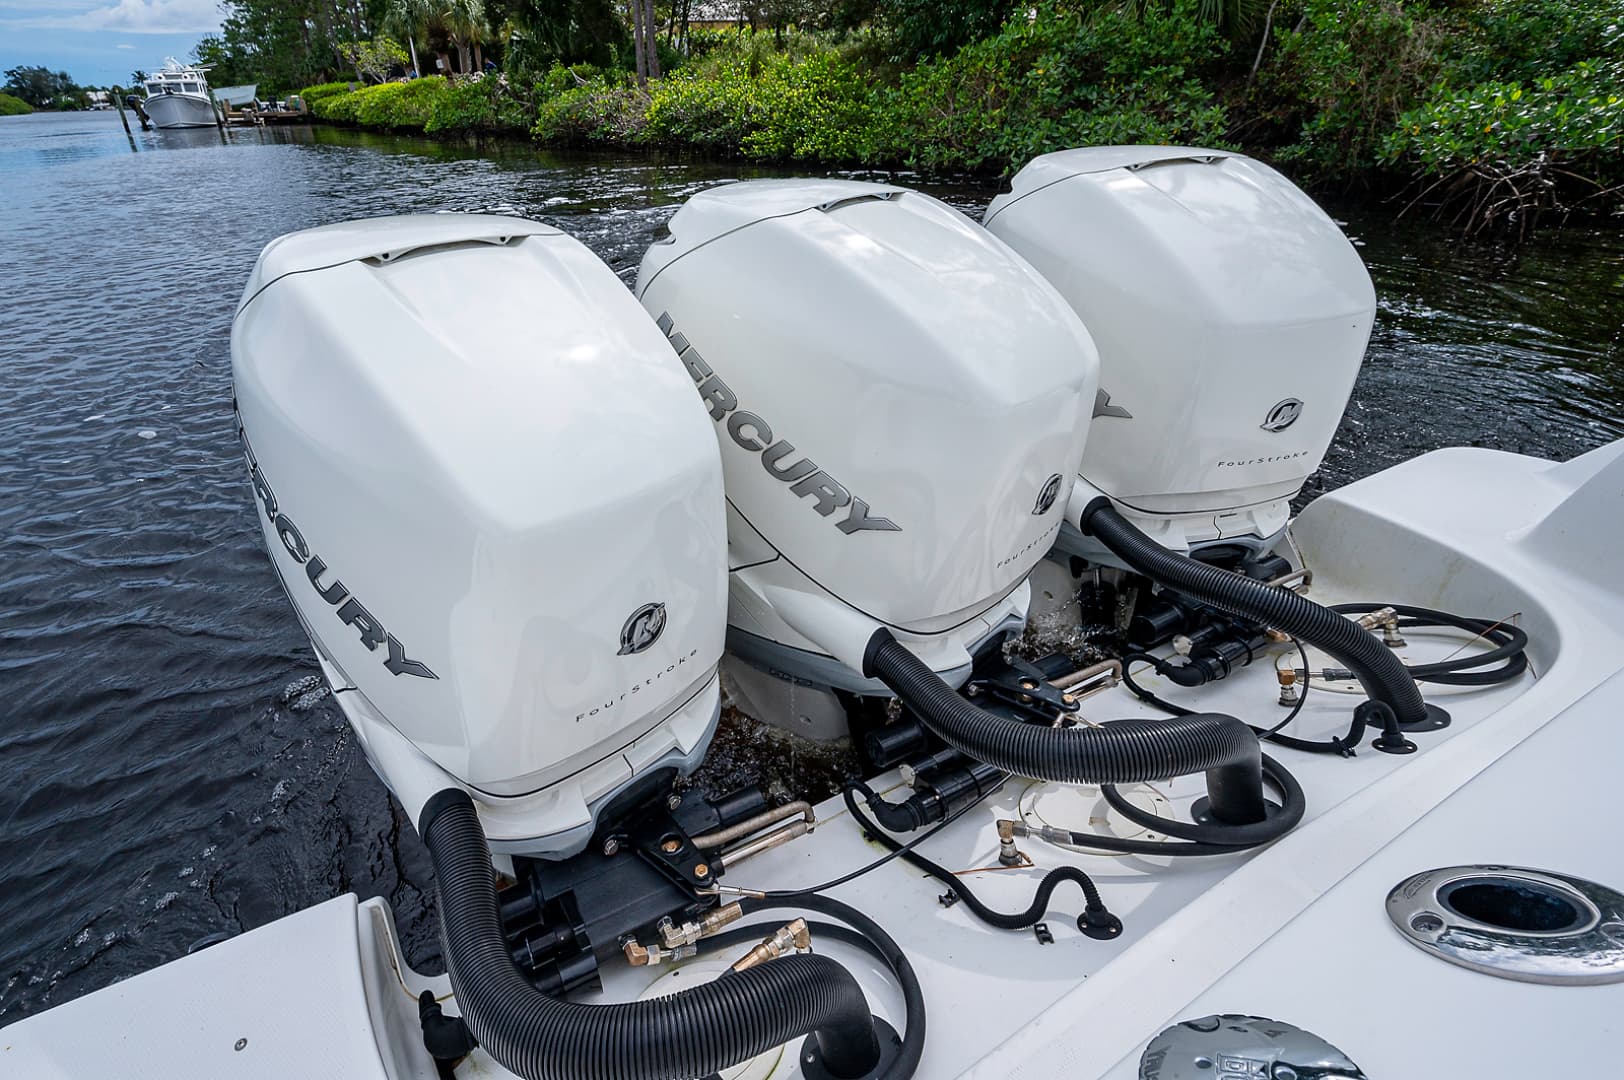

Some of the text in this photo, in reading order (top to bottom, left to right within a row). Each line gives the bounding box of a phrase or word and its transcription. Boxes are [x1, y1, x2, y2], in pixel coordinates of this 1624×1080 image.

[1217, 450, 1309, 468] FourStroke
[233, 397, 440, 680] RCURY
[575, 649, 697, 723] FourStroke
